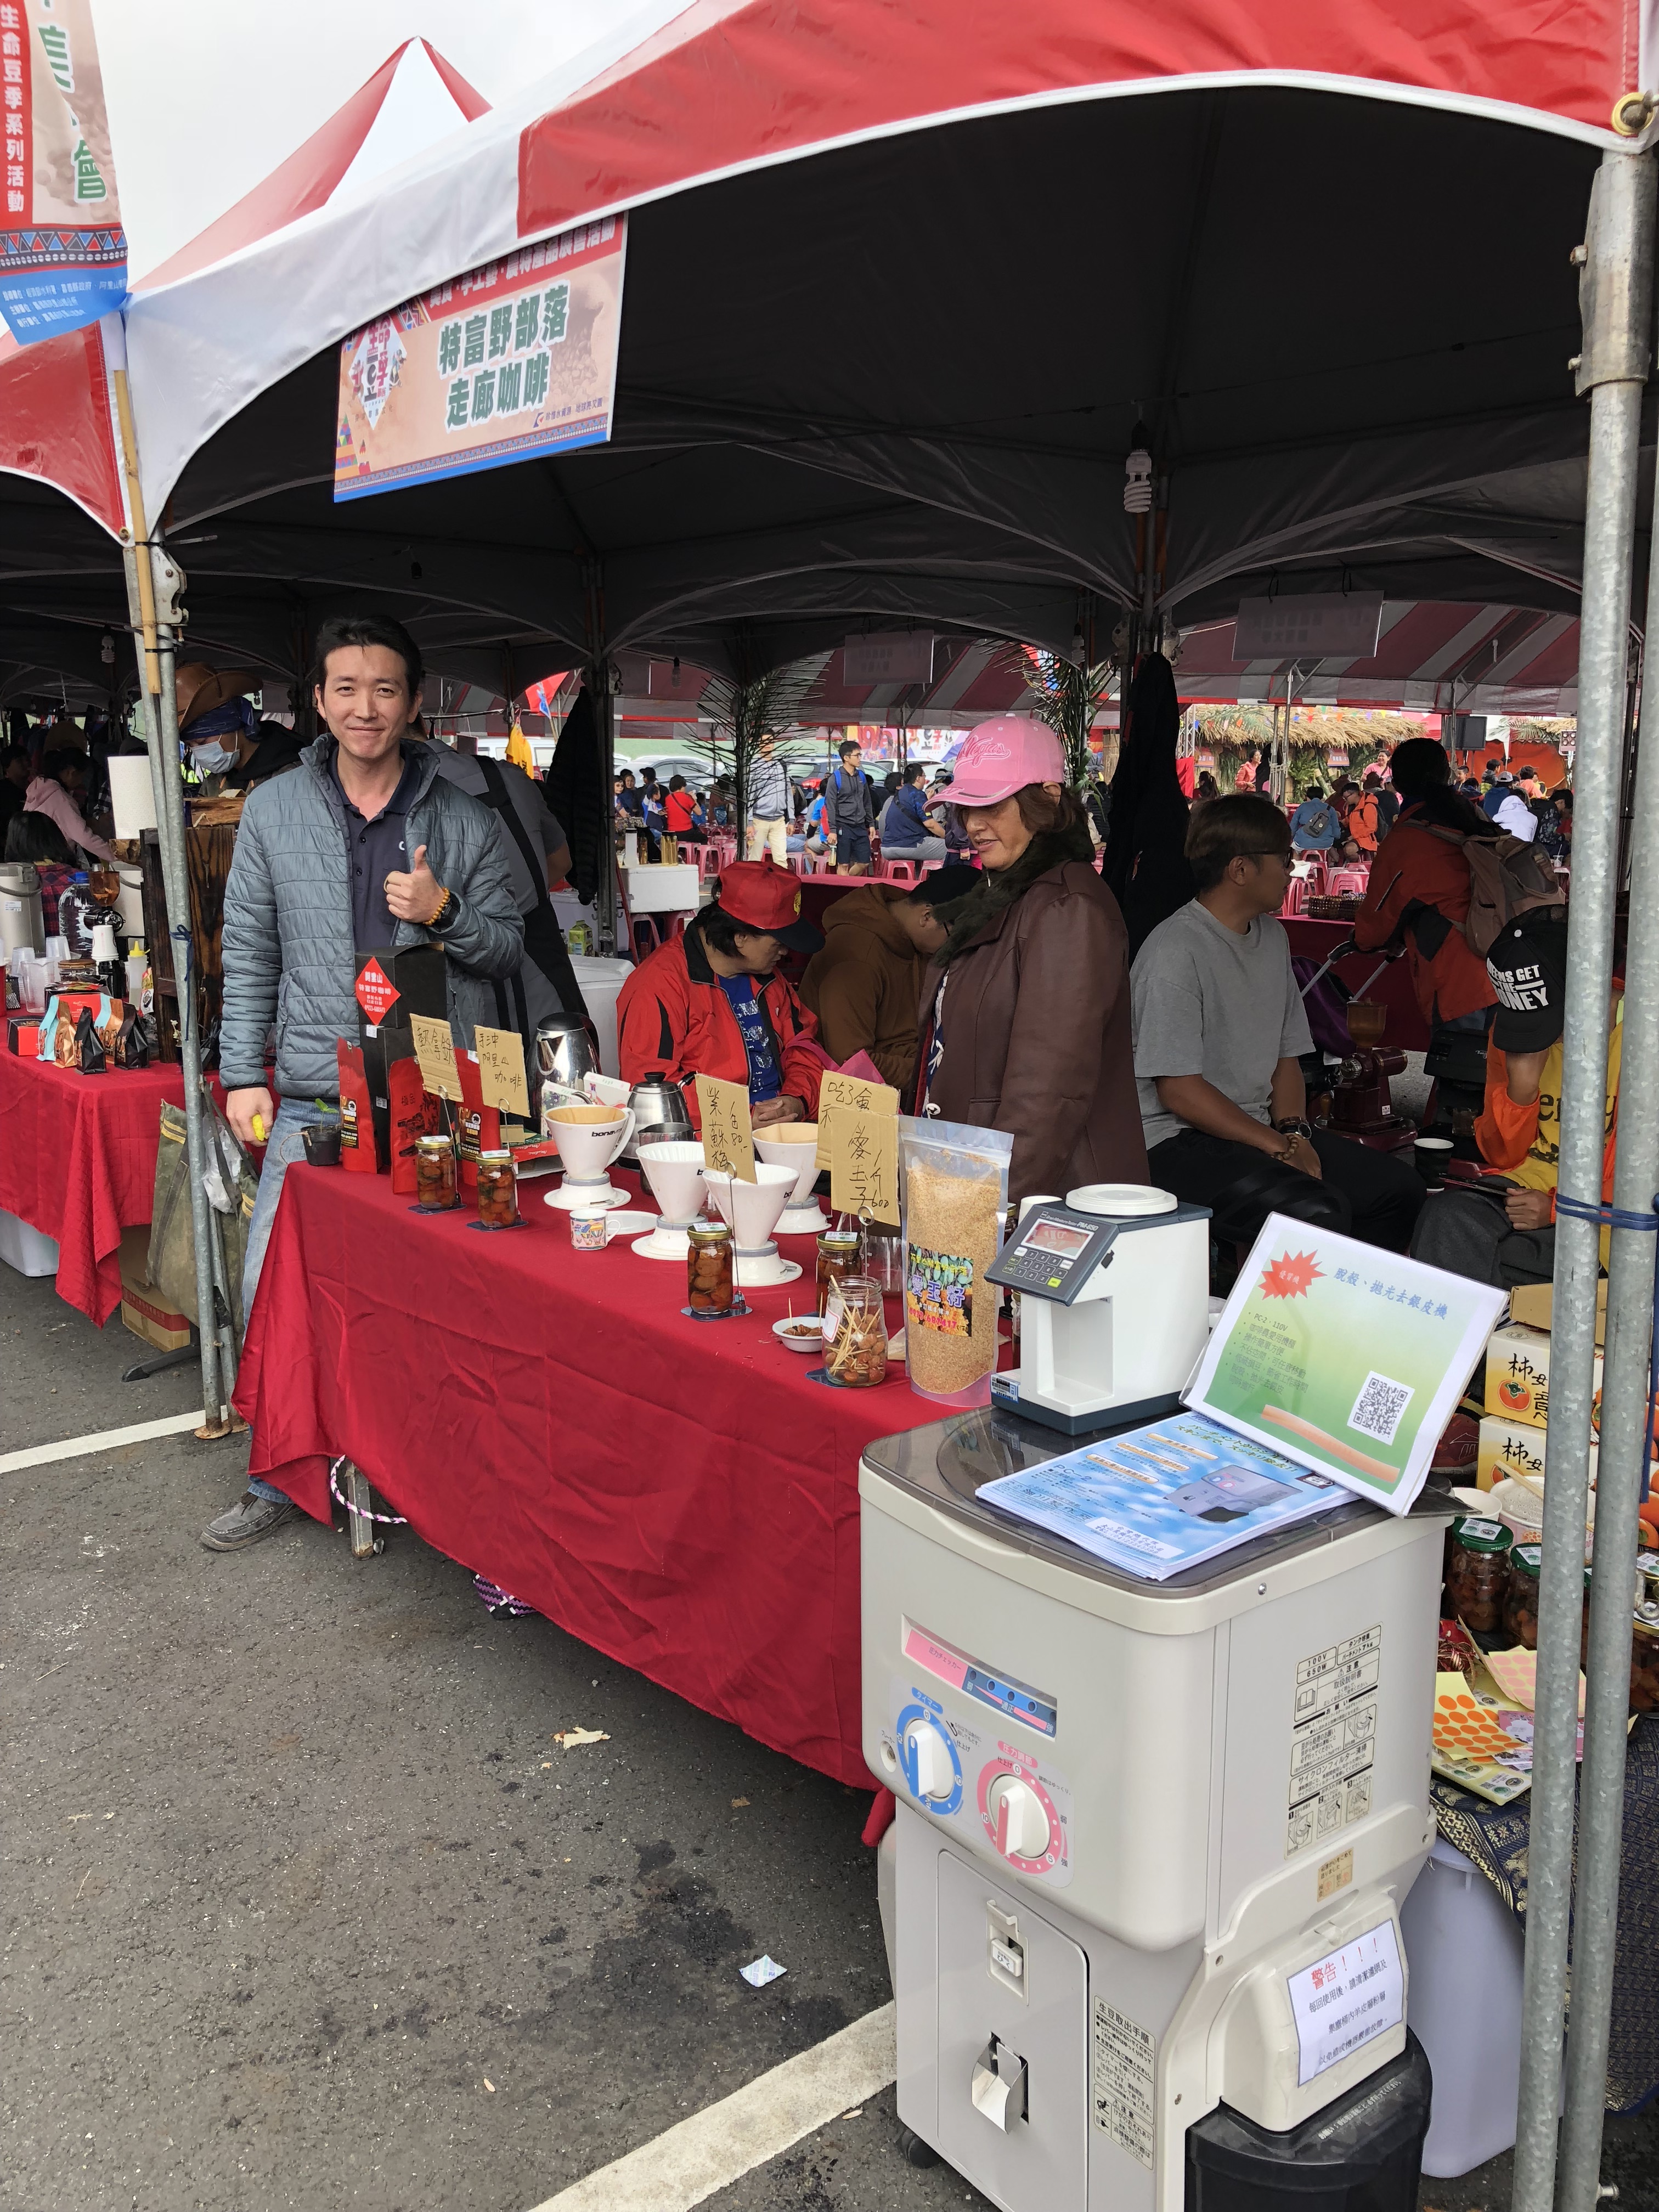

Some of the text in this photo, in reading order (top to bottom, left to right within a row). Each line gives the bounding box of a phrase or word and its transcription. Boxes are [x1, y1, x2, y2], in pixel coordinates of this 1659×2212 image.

[0, 3, 25, 213] 生命豆季系列活動
[439, 283, 569, 376] 特富野部落
[447, 351, 550, 430] 走廊咖啡
[365, 971, 383, 984] 阿里山
[1516, 964, 1541, 982] GET
[358, 984, 392, 996] 特富野咖啡
[1498, 981, 1517, 993] THE
[483, 1052, 509, 1068] 阿里山
[495, 1070, 522, 1092] 咖啡
[1077, 1221, 1099, 1231] PM-650
[1243, 1331, 1285, 1357] 操作簡單方便
[928, 1646, 962, 1670] 圧力チェッカー
[1346, 1660, 1359, 1674] 注意
[1334, 1669, 1362, 1690] 取扱説明書
[916, 1691, 939, 1709] タイマー
[967, 1680, 1054, 1734] 弱 適正 強
[897, 1734, 904, 1744] 30
[957, 1740, 970, 1752] 仕上げ
[1002, 1743, 1033, 1766] 圧力調節
[1298, 1742, 1367, 1784] サイクロンフィルター清掃
[997, 1756, 1020, 1774] 仕上げ 0
[955, 1776, 962, 1785] 10
[925, 1799, 932, 1809] 20
[981, 1813, 990, 1823] 10
[1060, 1814, 1068, 1825] 弱
[1047, 1854, 1054, 1863] 5
[1061, 1857, 1069, 1868] 強
[1099, 2002, 1150, 2046] 生豆取出手順
[1114, 2108, 1151, 2141] けがのおそれあり
